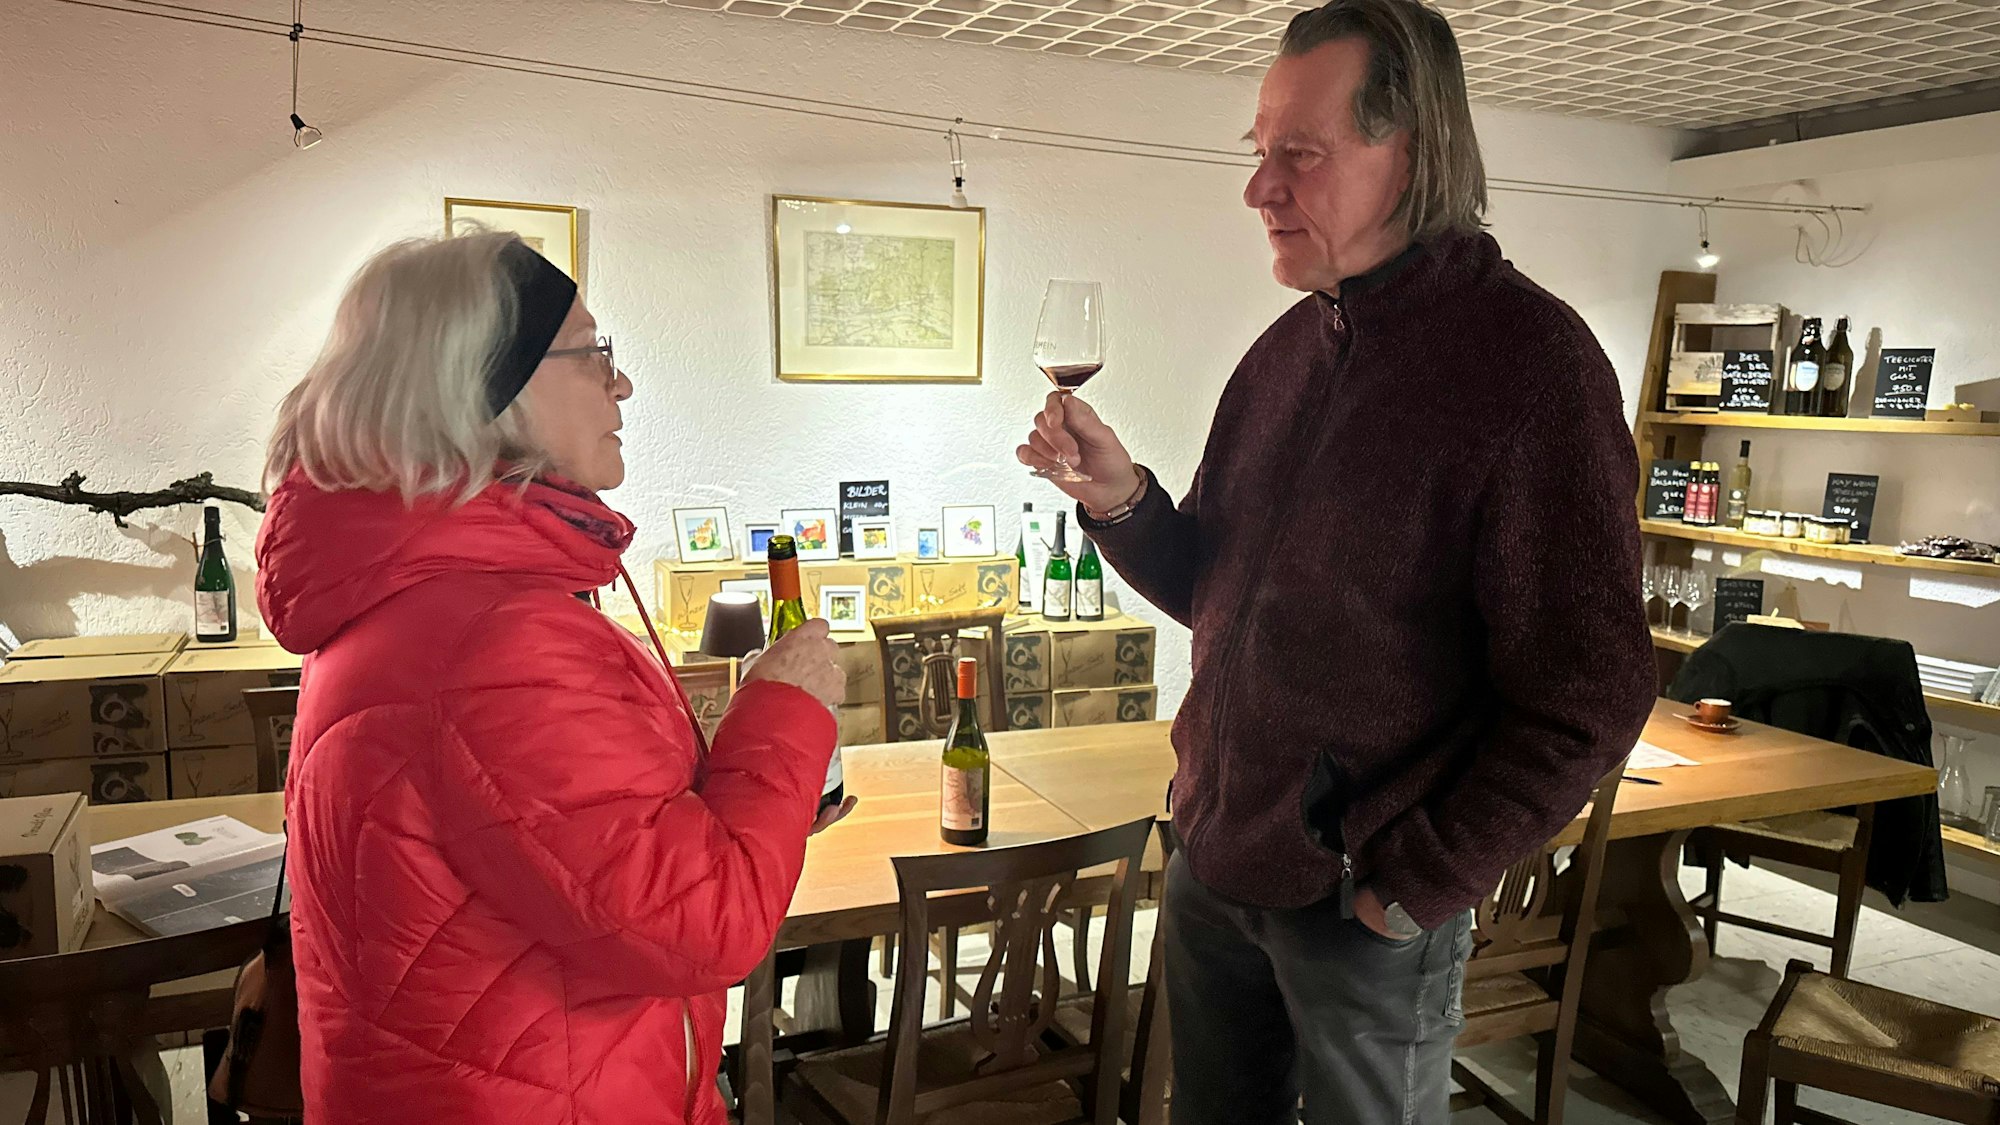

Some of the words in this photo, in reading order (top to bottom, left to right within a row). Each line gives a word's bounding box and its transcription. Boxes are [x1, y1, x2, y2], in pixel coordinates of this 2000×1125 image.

[1889, 373, 1916, 381] GLAS
[846, 484, 887, 498] BILDER
[843, 502, 868, 510] KLEIN
